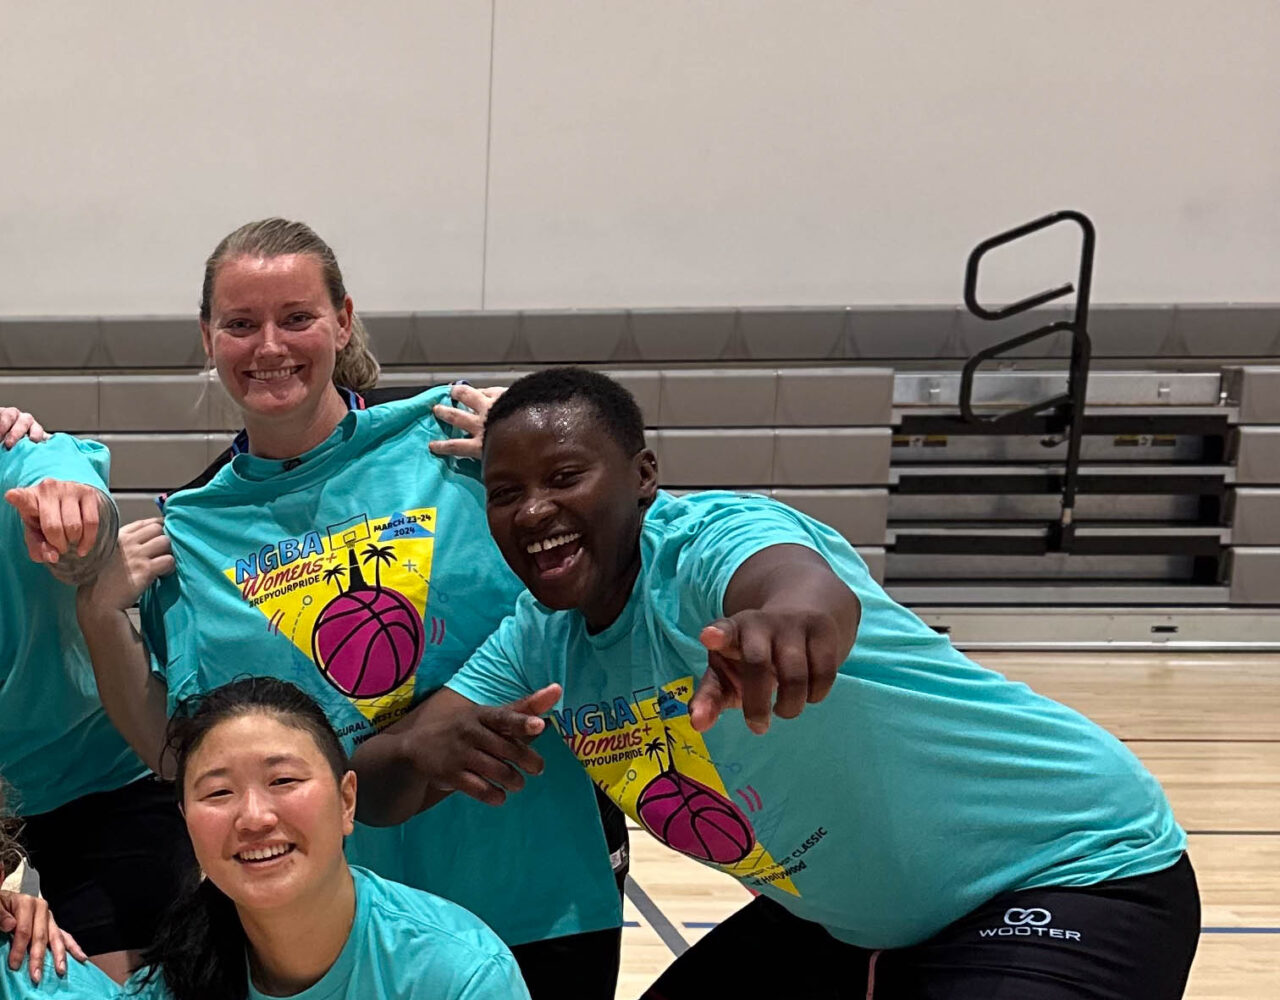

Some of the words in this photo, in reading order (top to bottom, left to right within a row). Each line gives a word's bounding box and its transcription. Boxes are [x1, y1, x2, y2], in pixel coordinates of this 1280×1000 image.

[373, 516, 405, 532] MARCH
[406, 514, 432, 524] 23-24
[394, 527, 416, 537] 2024
[235, 531, 324, 584] NGBA
[249, 574, 320, 608] #REPYOURPRIDE
[337, 721, 367, 737] GURAL
[792, 826, 828, 858] CLASSIC
[761, 860, 807, 884] Hollywood
[979, 926, 1082, 942] WOOTER
